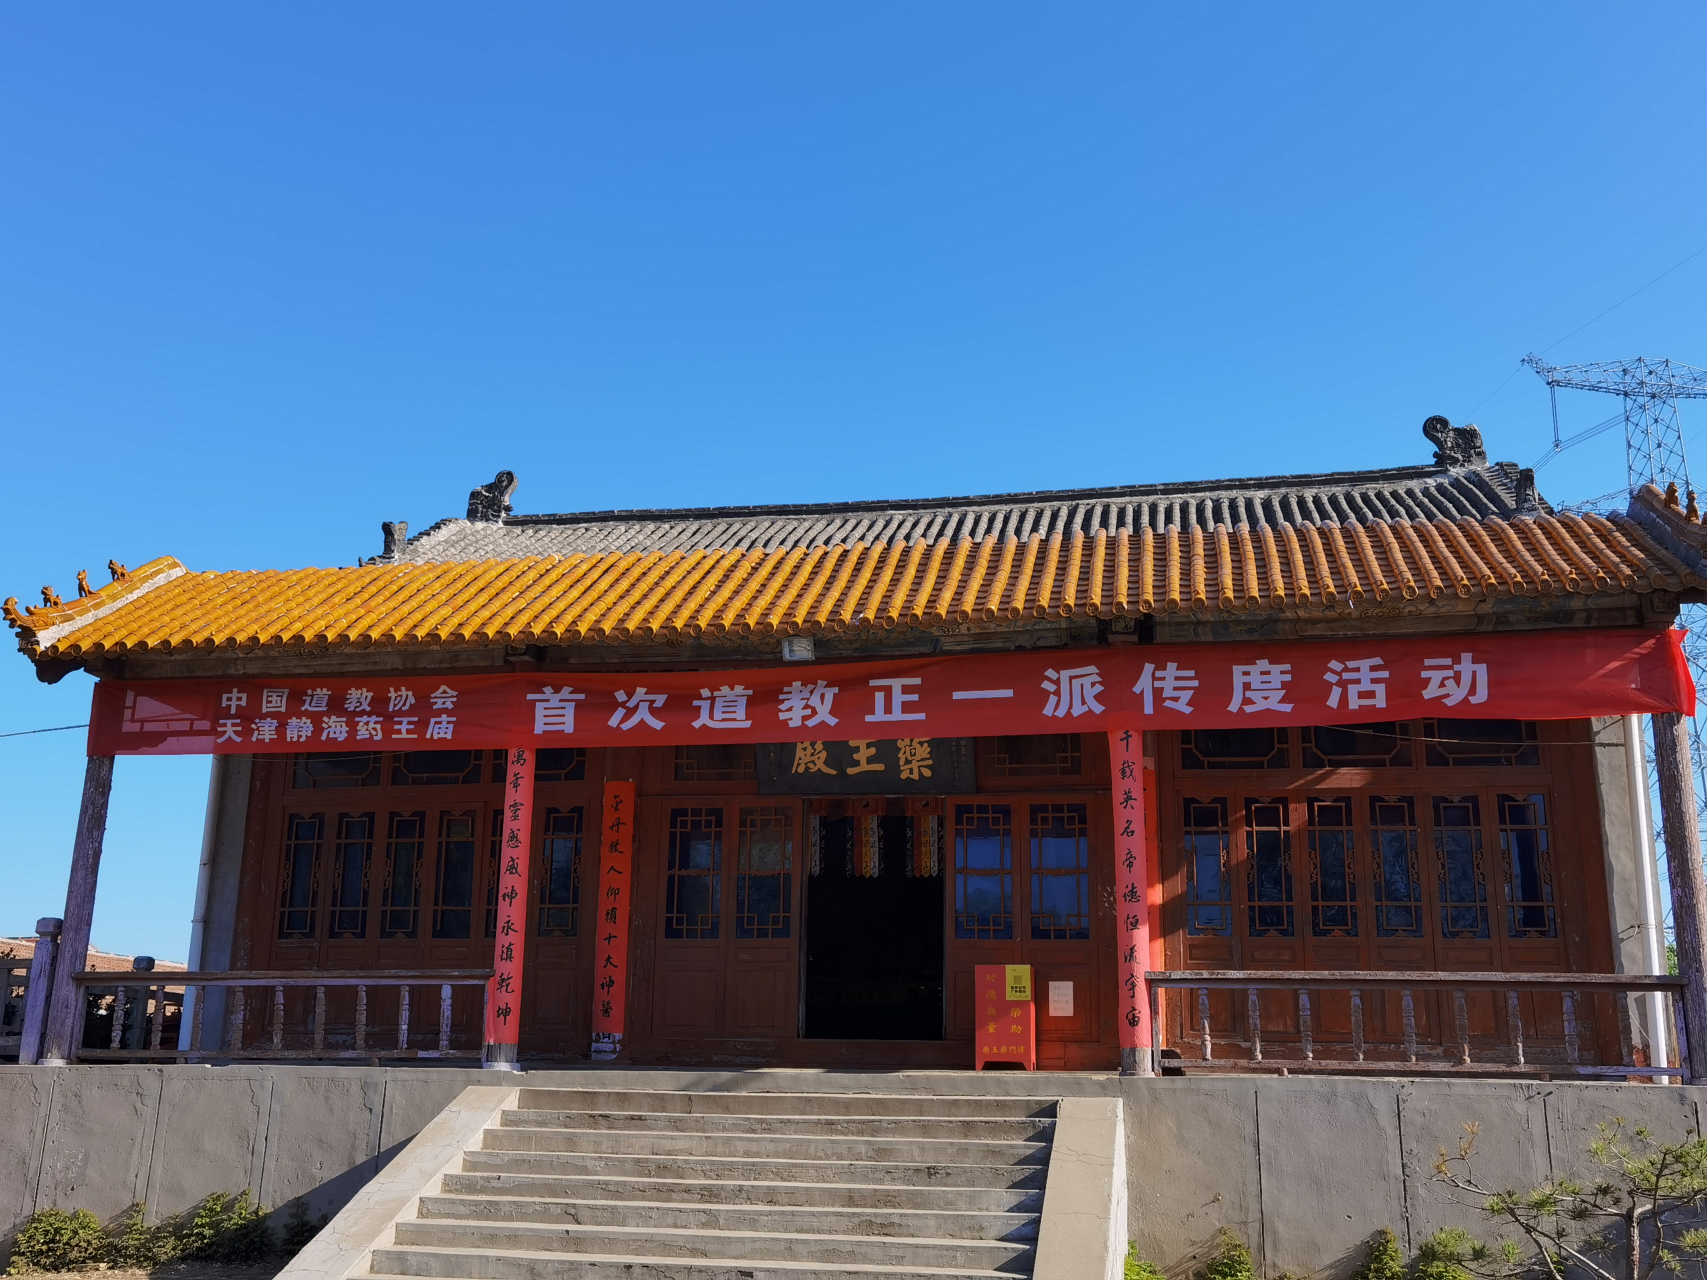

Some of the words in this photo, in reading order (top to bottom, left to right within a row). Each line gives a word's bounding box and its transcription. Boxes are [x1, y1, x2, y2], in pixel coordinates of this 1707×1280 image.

[221, 685, 458, 714] 中国道教协会
[526, 652, 1489, 734] 首次道教正一派传度活动
[216, 714, 457, 743] 天津静海药王庙
